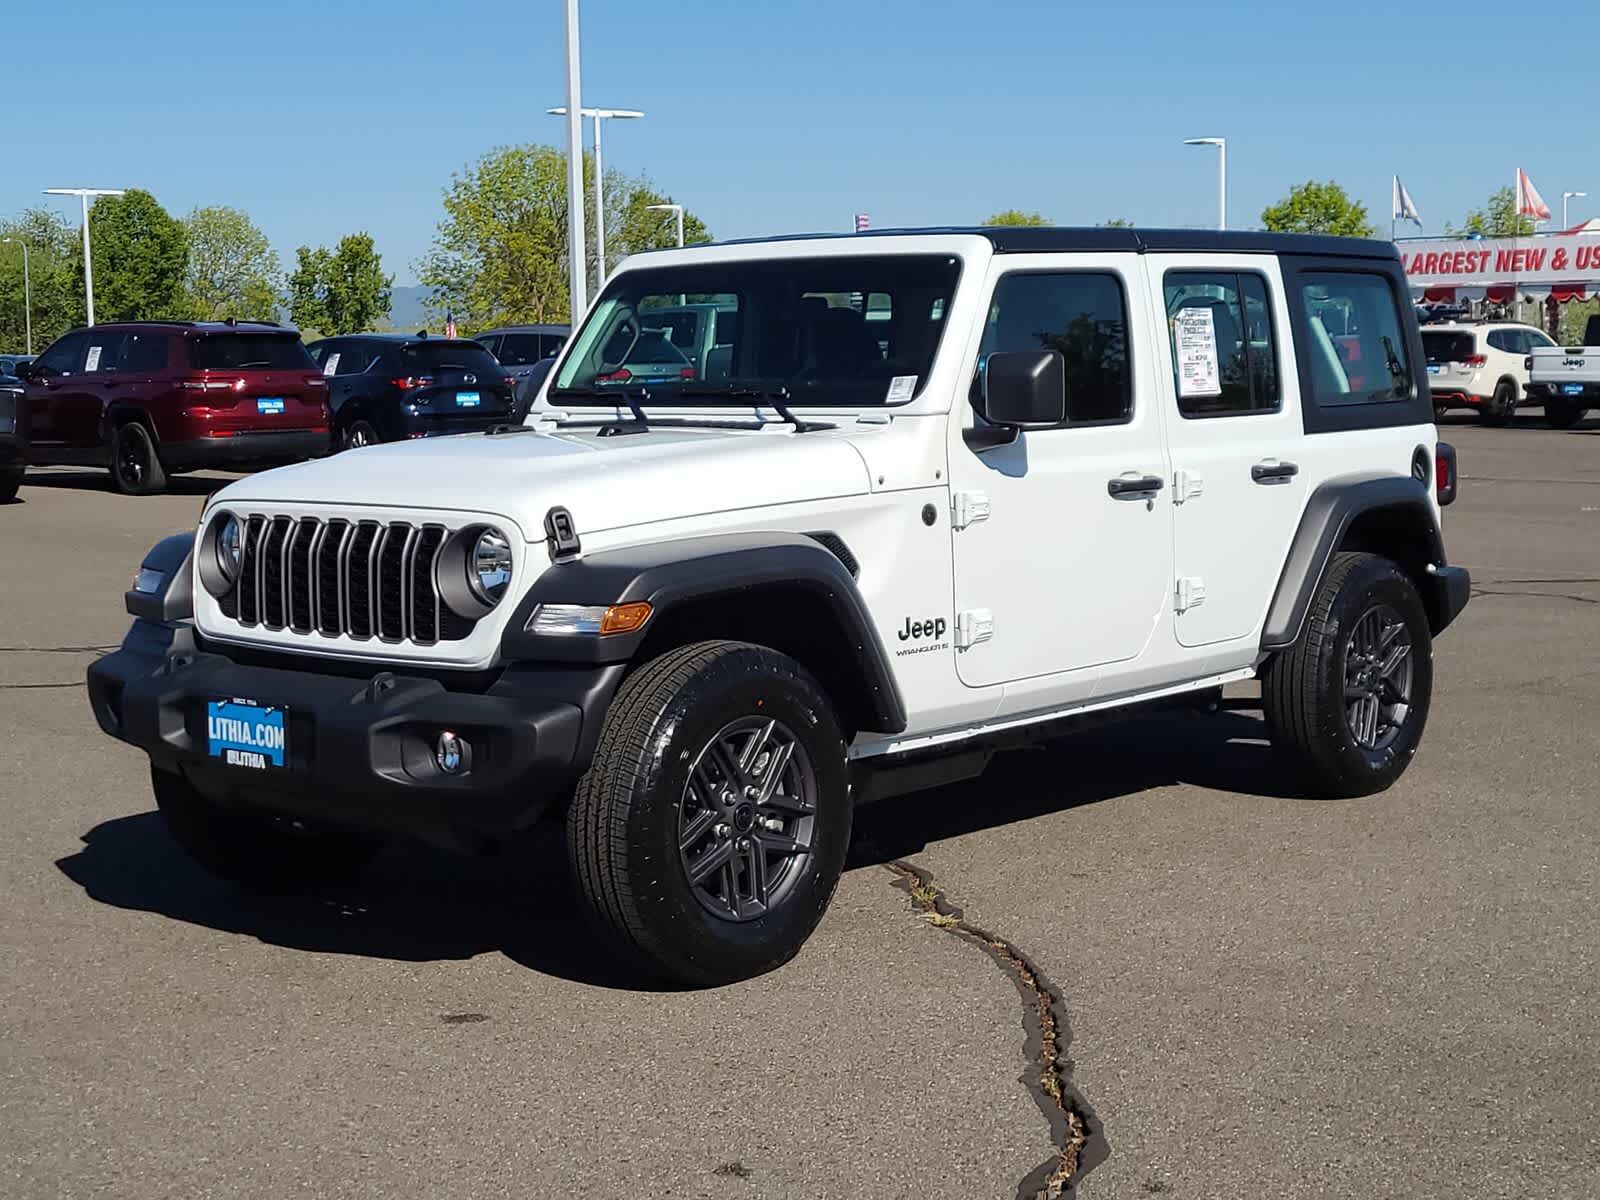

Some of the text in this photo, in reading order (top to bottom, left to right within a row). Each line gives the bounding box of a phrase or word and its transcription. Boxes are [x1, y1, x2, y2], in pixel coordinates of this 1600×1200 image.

[1494, 247, 1547, 273] NEW
[1551, 247, 1569, 271] &
[1562, 358, 1585, 368] Jeep
[898, 616, 946, 641] Jeep
[208, 715, 285, 751] LITHIA.COM
